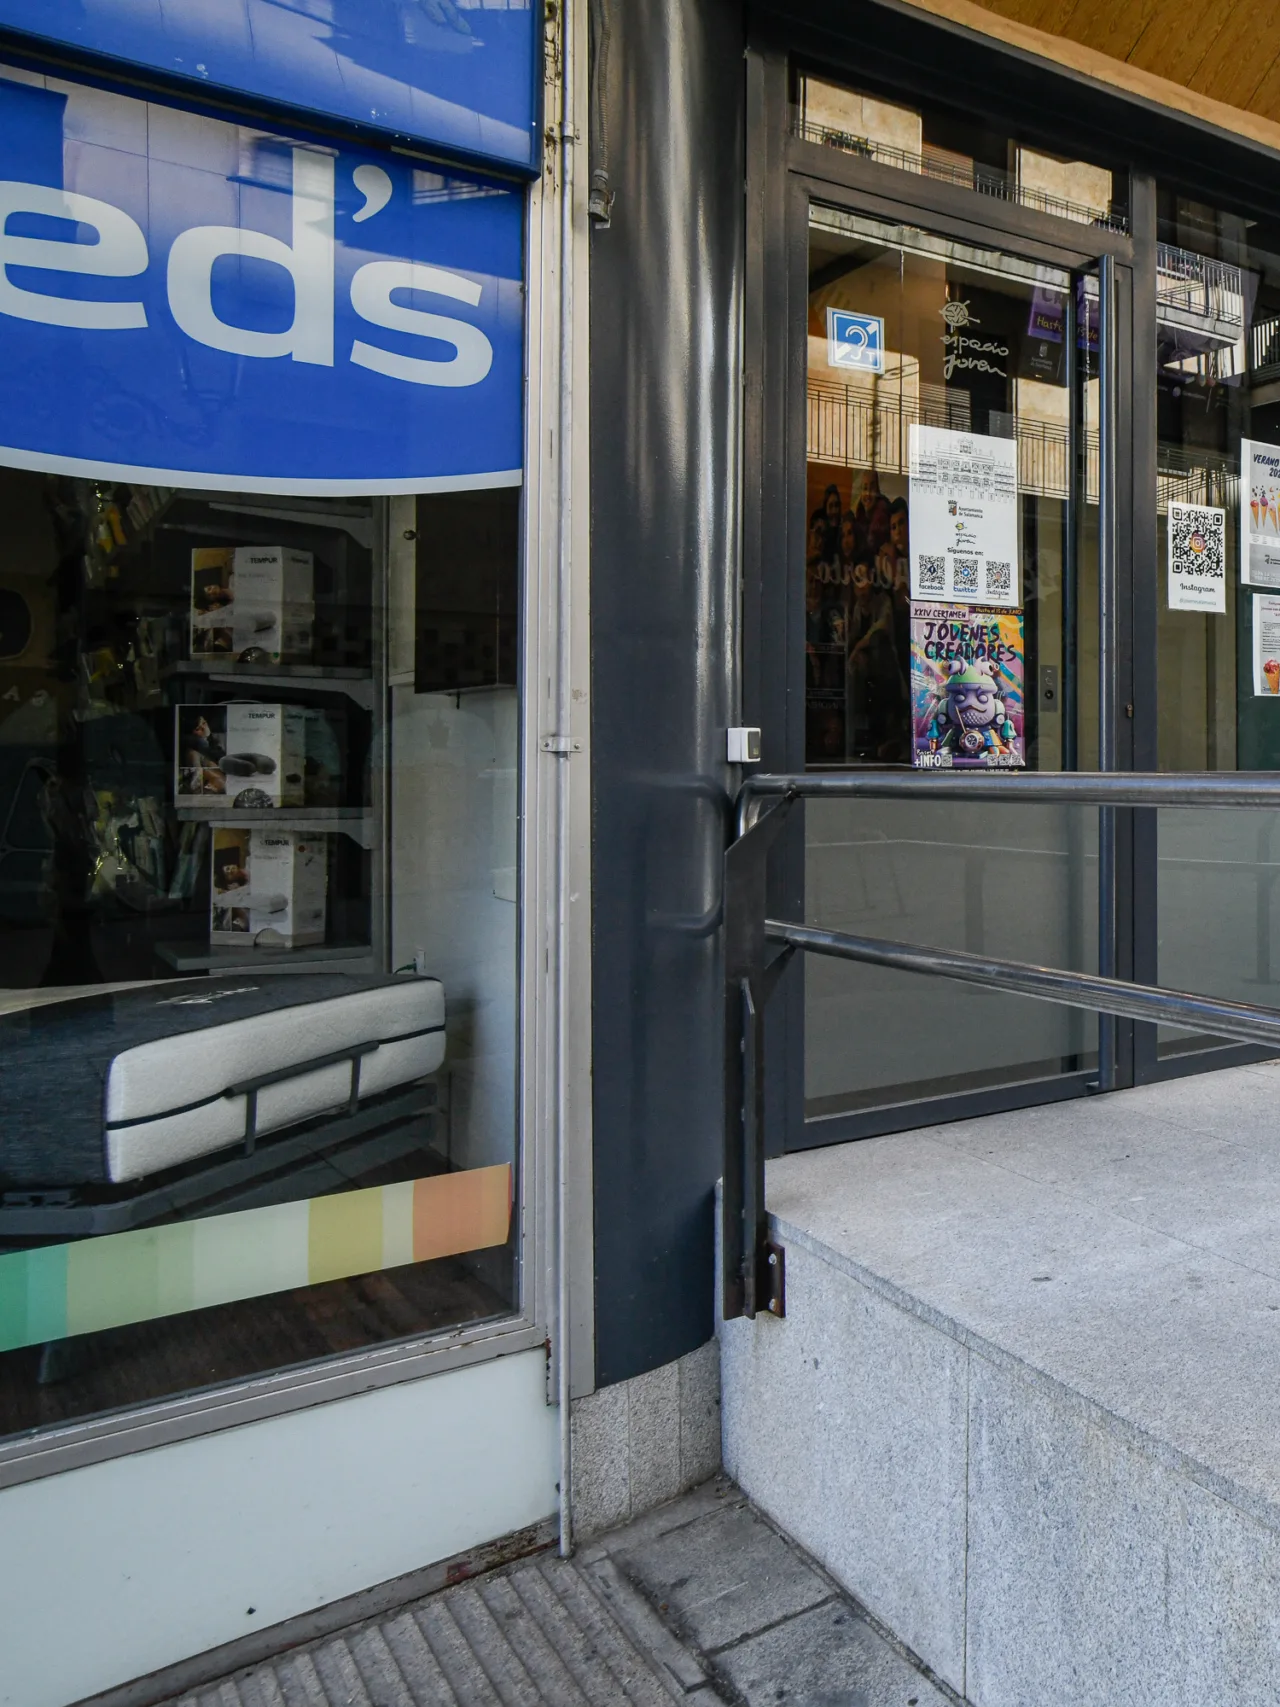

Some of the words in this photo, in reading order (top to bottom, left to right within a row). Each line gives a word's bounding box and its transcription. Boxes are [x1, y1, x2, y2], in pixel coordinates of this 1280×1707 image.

[940, 335, 1009, 356] espacio
[943, 350, 1007, 380] joven
[1253, 453, 1280, 468] VERANO
[958, 506, 983, 514] Ayuntamiento
[947, 547, 973, 556] Síguenos
[1179, 582, 1216, 594] Instagram
[914, 608, 932, 617] XXIV
[933, 608, 966, 620] CERTAMEN
[923, 620, 1000, 644] JÓVENES
[924, 640, 1017, 662] CREADORES
